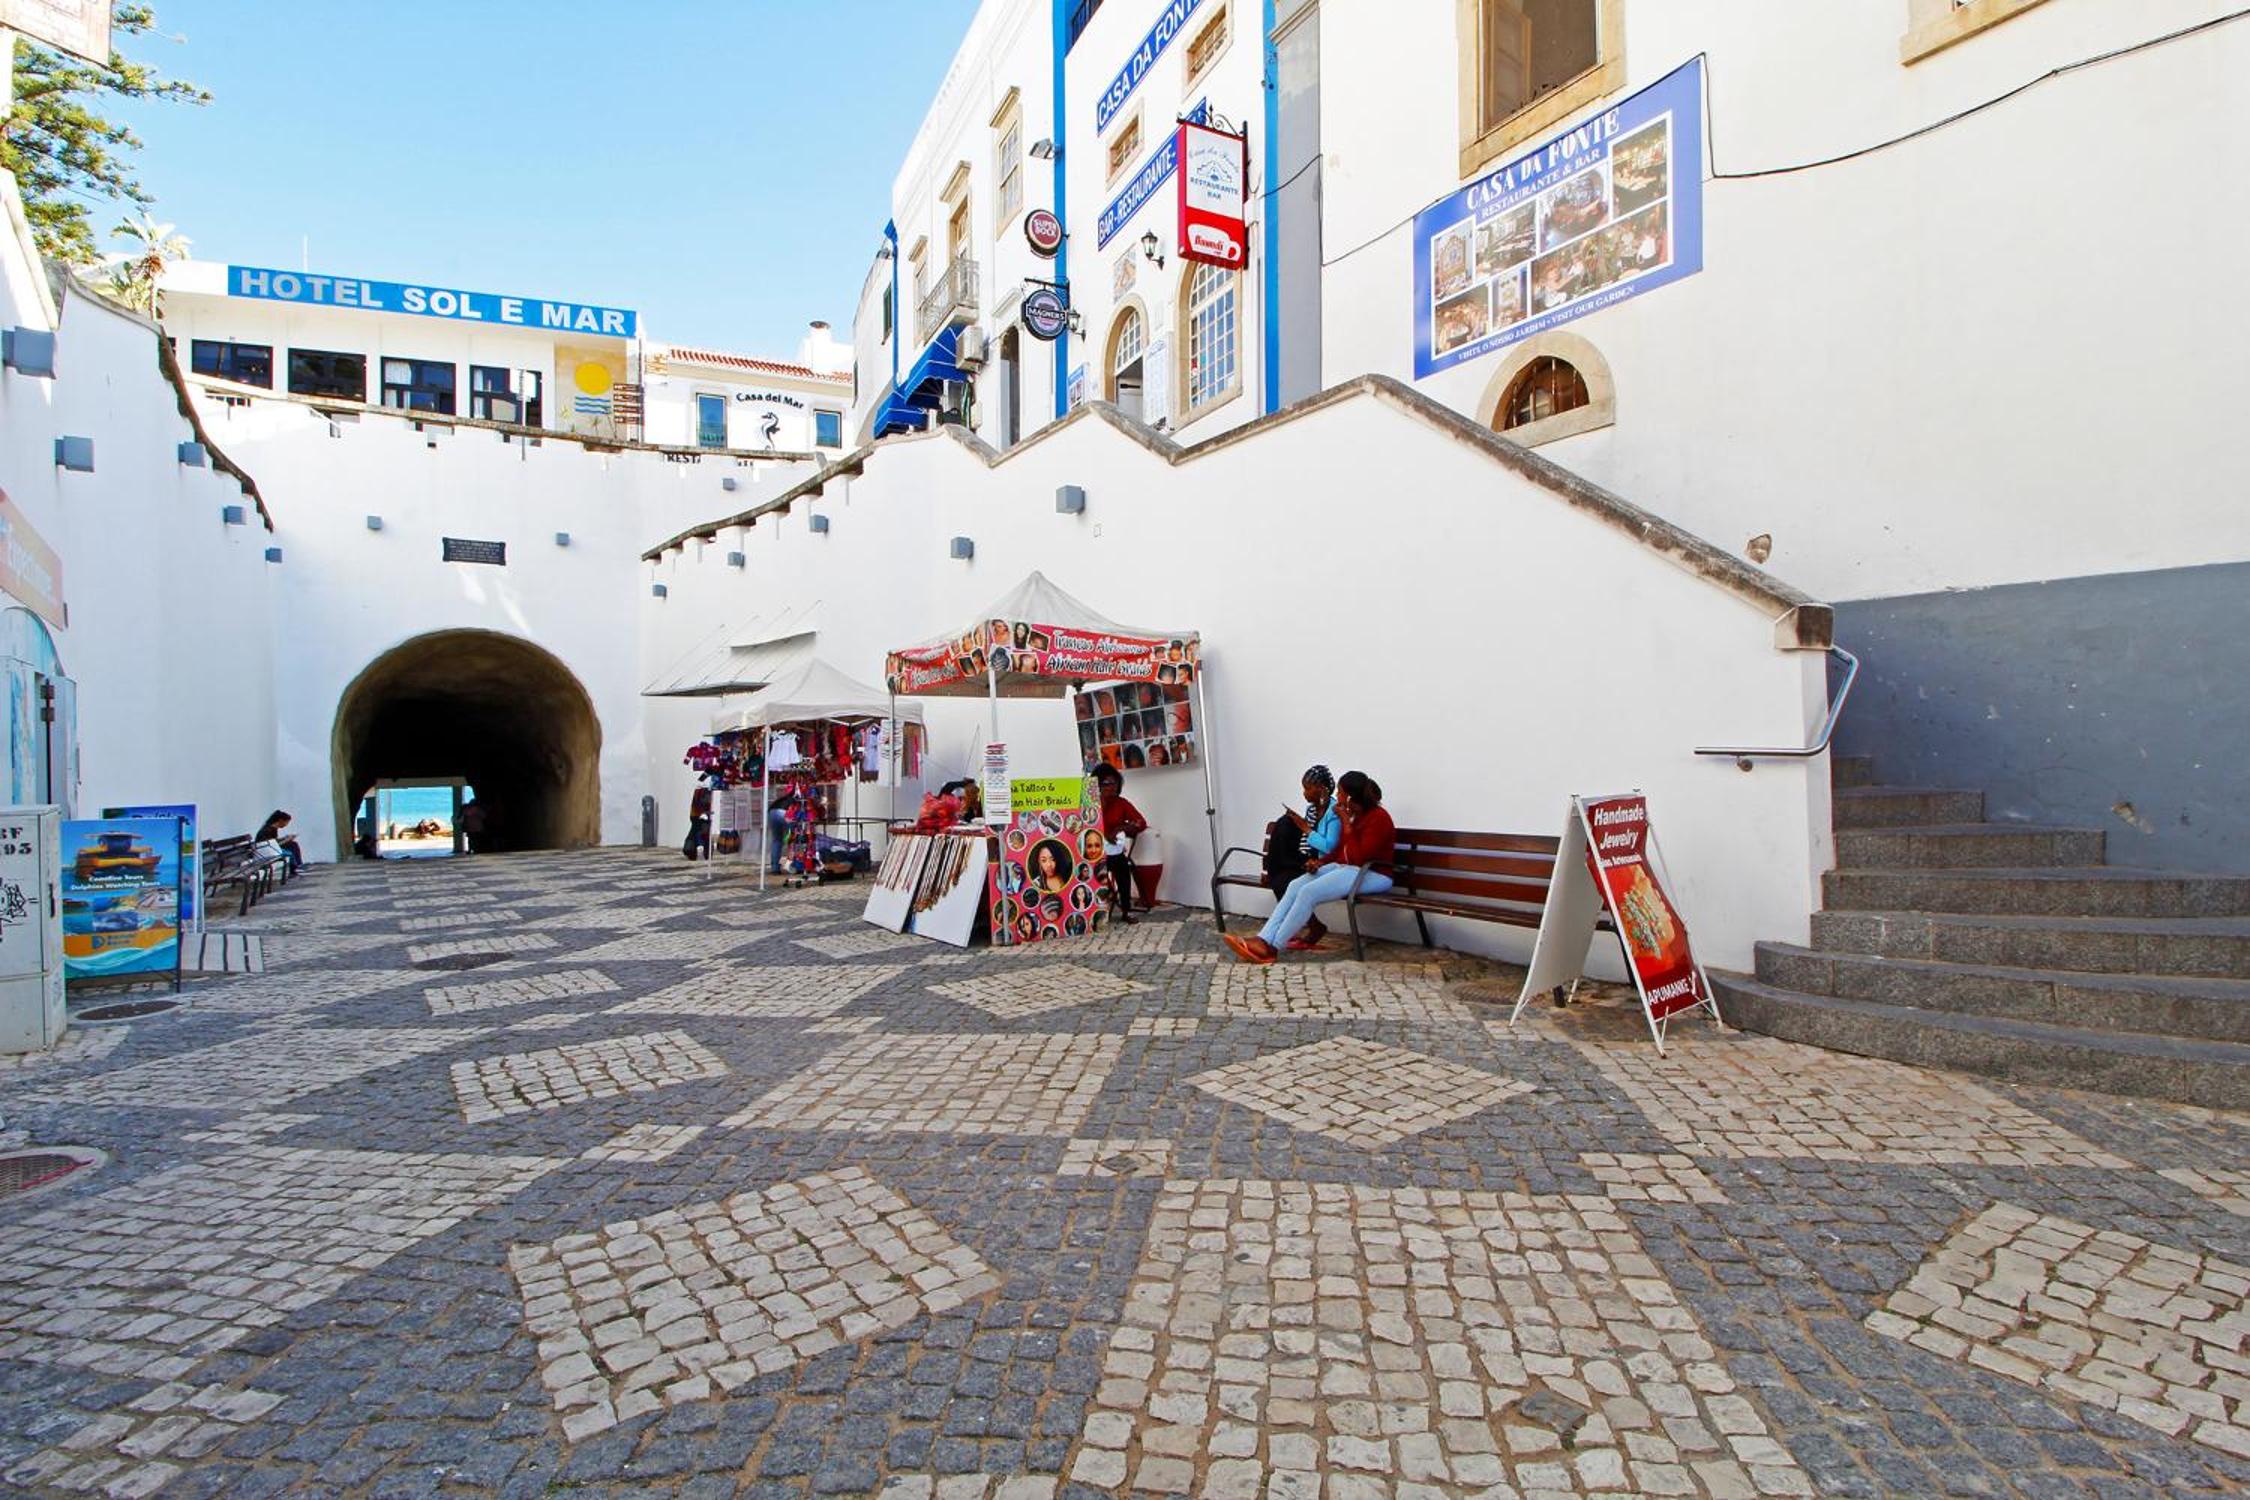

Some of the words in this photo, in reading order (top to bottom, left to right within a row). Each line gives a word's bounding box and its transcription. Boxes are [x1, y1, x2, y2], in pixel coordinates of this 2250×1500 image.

[1099, 71, 1131, 126] CASA
[1133, 42, 1153, 82] DA
[1155, 0, 1201, 53] FON
[1467, 167, 1515, 210] CASA
[1520, 155, 1543, 181] DA
[1548, 107, 1620, 169] FONTE
[1481, 169, 1561, 219] RESTAURANTE
[1563, 164, 1572, 174] &
[1576, 148, 1600, 170] BAR
[240, 269, 384, 308] HOTEL
[401, 287, 482, 319] SOL
[501, 298, 524, 323] E
[542, 302, 626, 335] MAR
[1514, 319, 1546, 338] JARDIM
[1551, 309, 1574, 324] VISIT
[1575, 302, 1595, 314] OUR
[1595, 284, 1636, 306] GARDEN
[736, 392, 763, 402] Casa
[765, 392, 781, 403] del
[784, 397, 805, 410] Mar
[1594, 804, 1644, 826] Handmade
[1600, 829, 1639, 850] Jewelry
